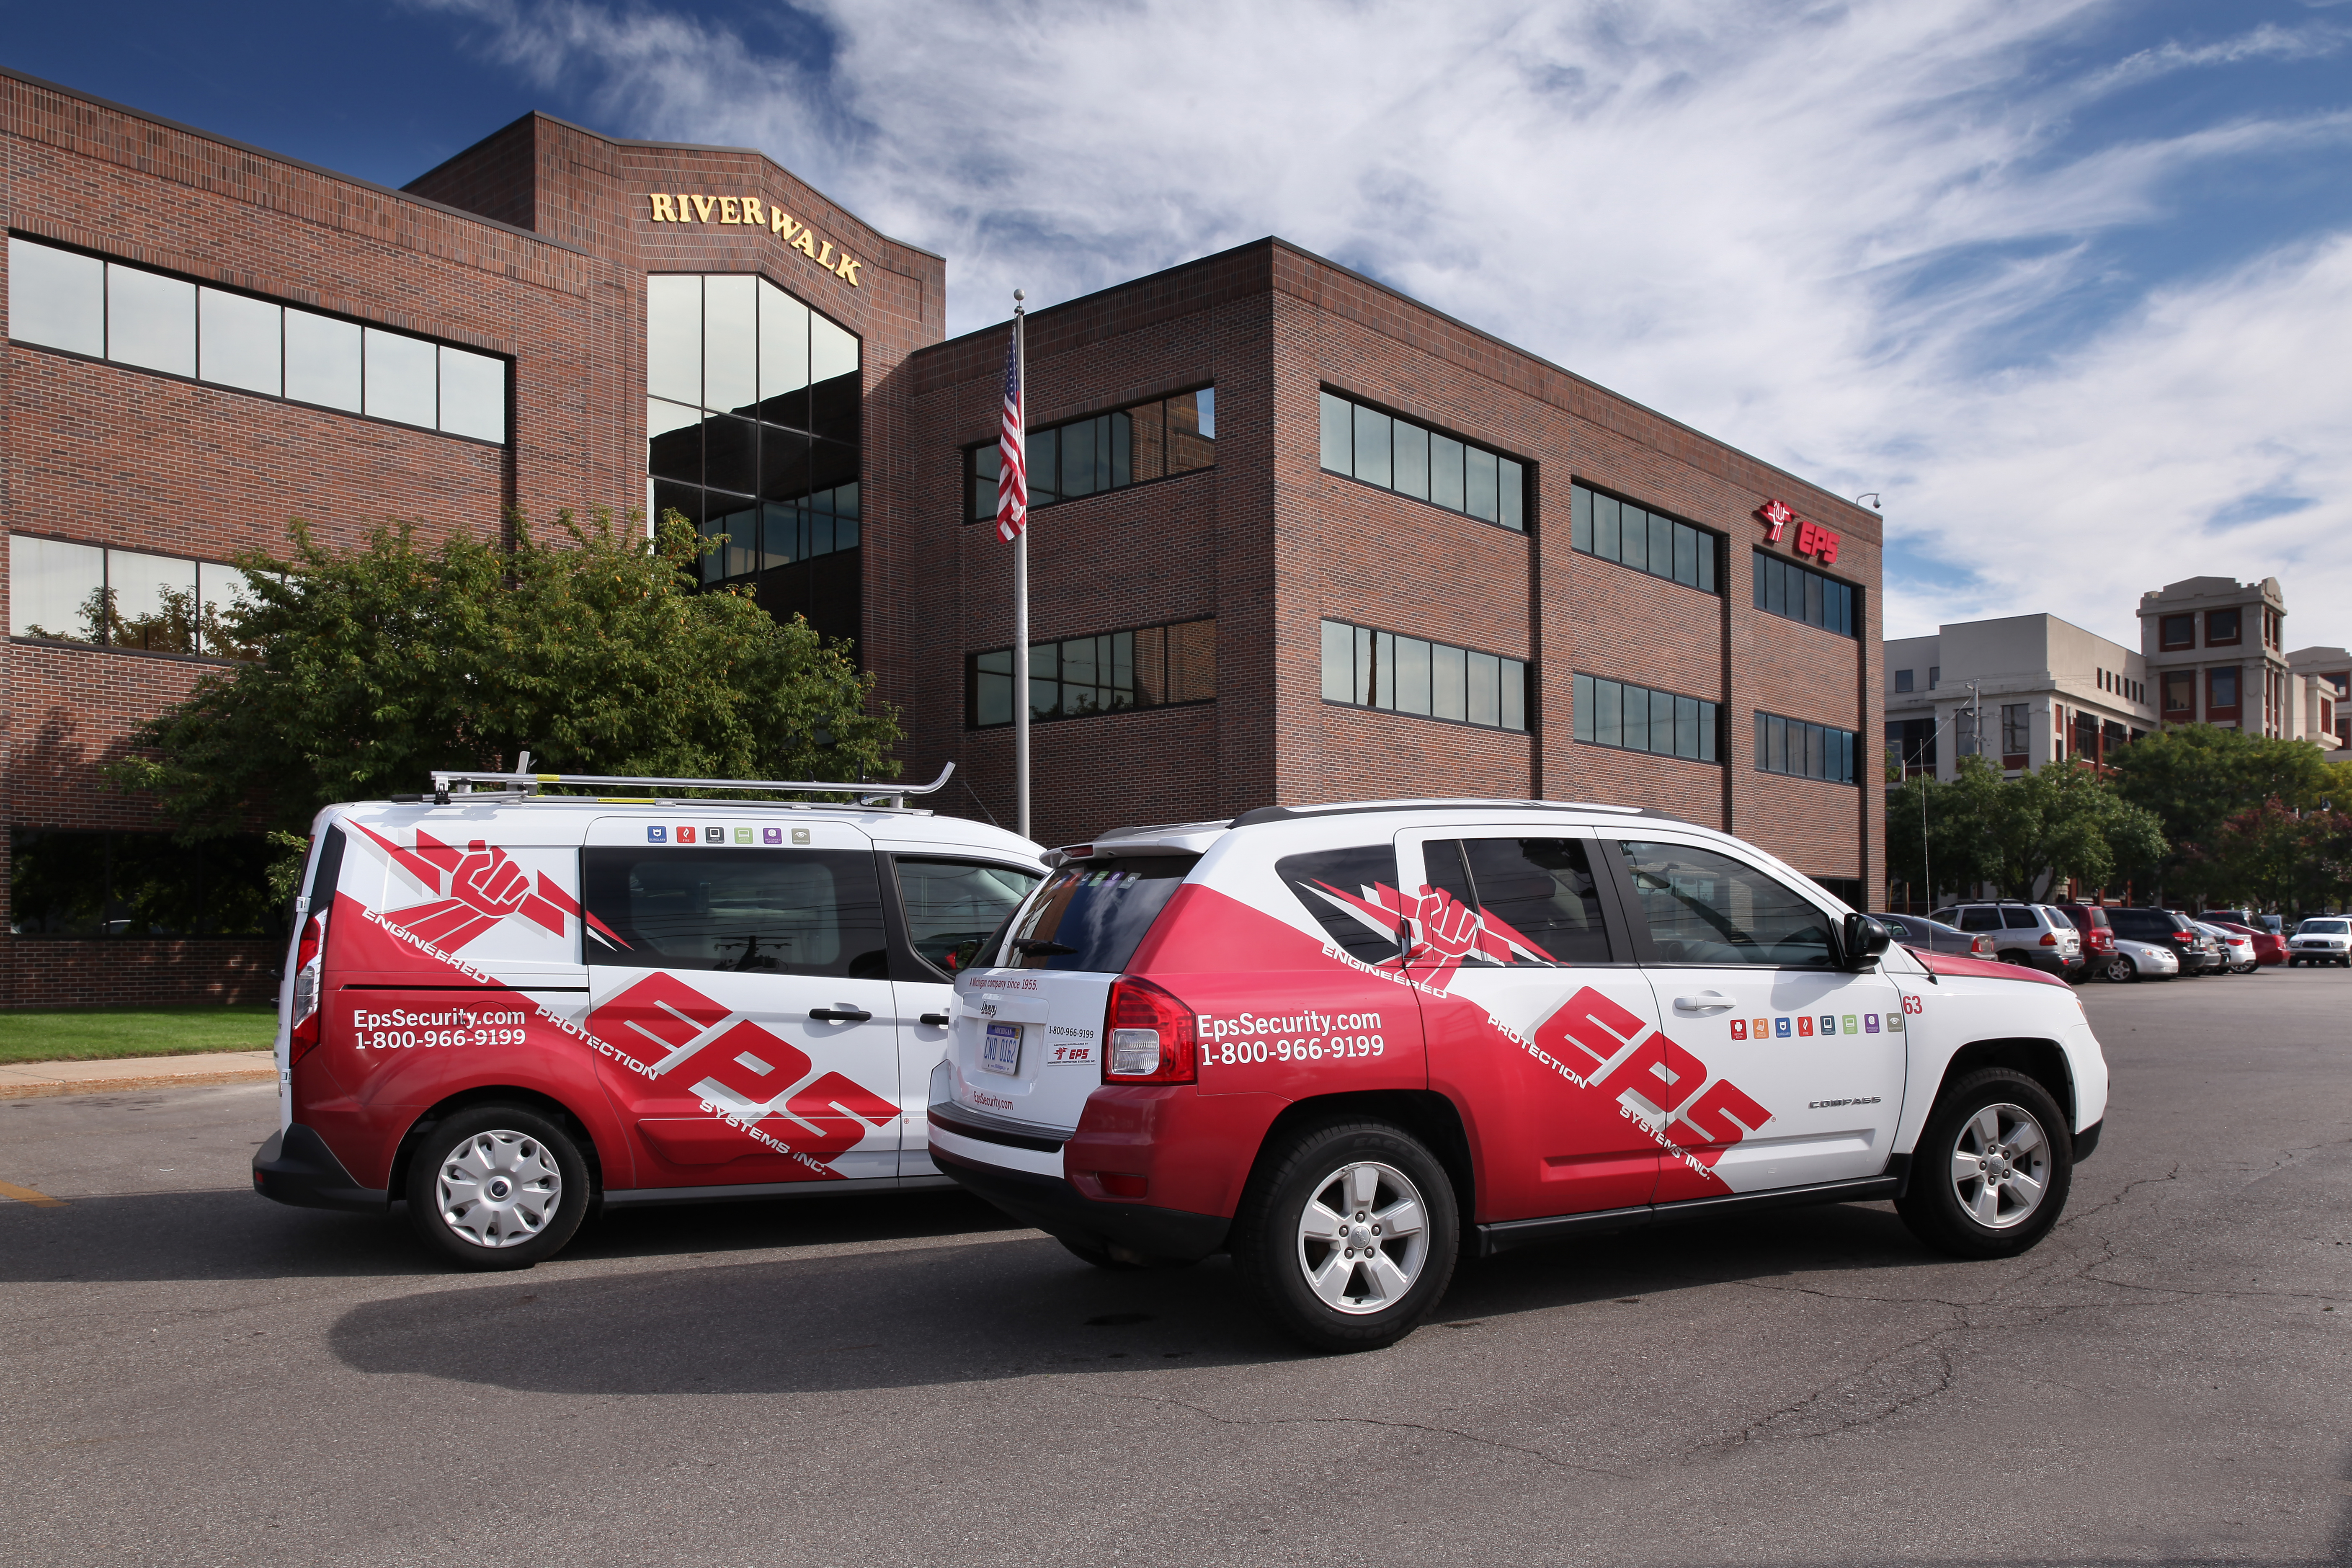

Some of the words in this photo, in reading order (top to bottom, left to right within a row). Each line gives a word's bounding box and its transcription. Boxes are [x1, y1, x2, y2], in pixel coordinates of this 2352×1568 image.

[1799, 521, 1840, 564] EPS
[362, 906, 490, 984] ENGINEERED
[969, 977, 972, 987] A
[972, 977, 987, 989] Michigan
[987, 980, 1007, 990] company
[1007, 978, 1020, 989] since
[1021, 979, 1038, 990] 1955.
[1322, 943, 1447, 999] ENGINEERED
[980, 1000, 997, 1018] Jeep
[1903, 995, 1923, 1015] 63
[354, 1008, 525, 1032] EpsSecurity.com
[995, 1027, 1012, 1035] MICHIGAN
[1049, 1025, 1094, 1039] 1-800-966-9199
[1197, 1010, 1382, 1042] EpsSecurity.com
[355, 1029, 526, 1050] 1-800-966-9199
[535, 1005, 658, 1081] PROTECTION
[1000, 1039, 1016, 1063] 0162
[1201, 1034, 1384, 1066] 1-800-966-9199
[1487, 1013, 1589, 1089] PROTECTION
[585, 972, 903, 1163] EPS
[1069, 1049, 1090, 1060] EPS
[1534, 986, 1773, 1168] EPS
[974, 1091, 1014, 1110] EpsSecurity.com
[1809, 1095, 1882, 1109] COMPASS
[699, 1099, 790, 1154] SYSTEMS
[793, 1151, 826, 1176] INC.
[1620, 1105, 1683, 1159] SYSTEMS
[1685, 1154, 1710, 1180] INC.
